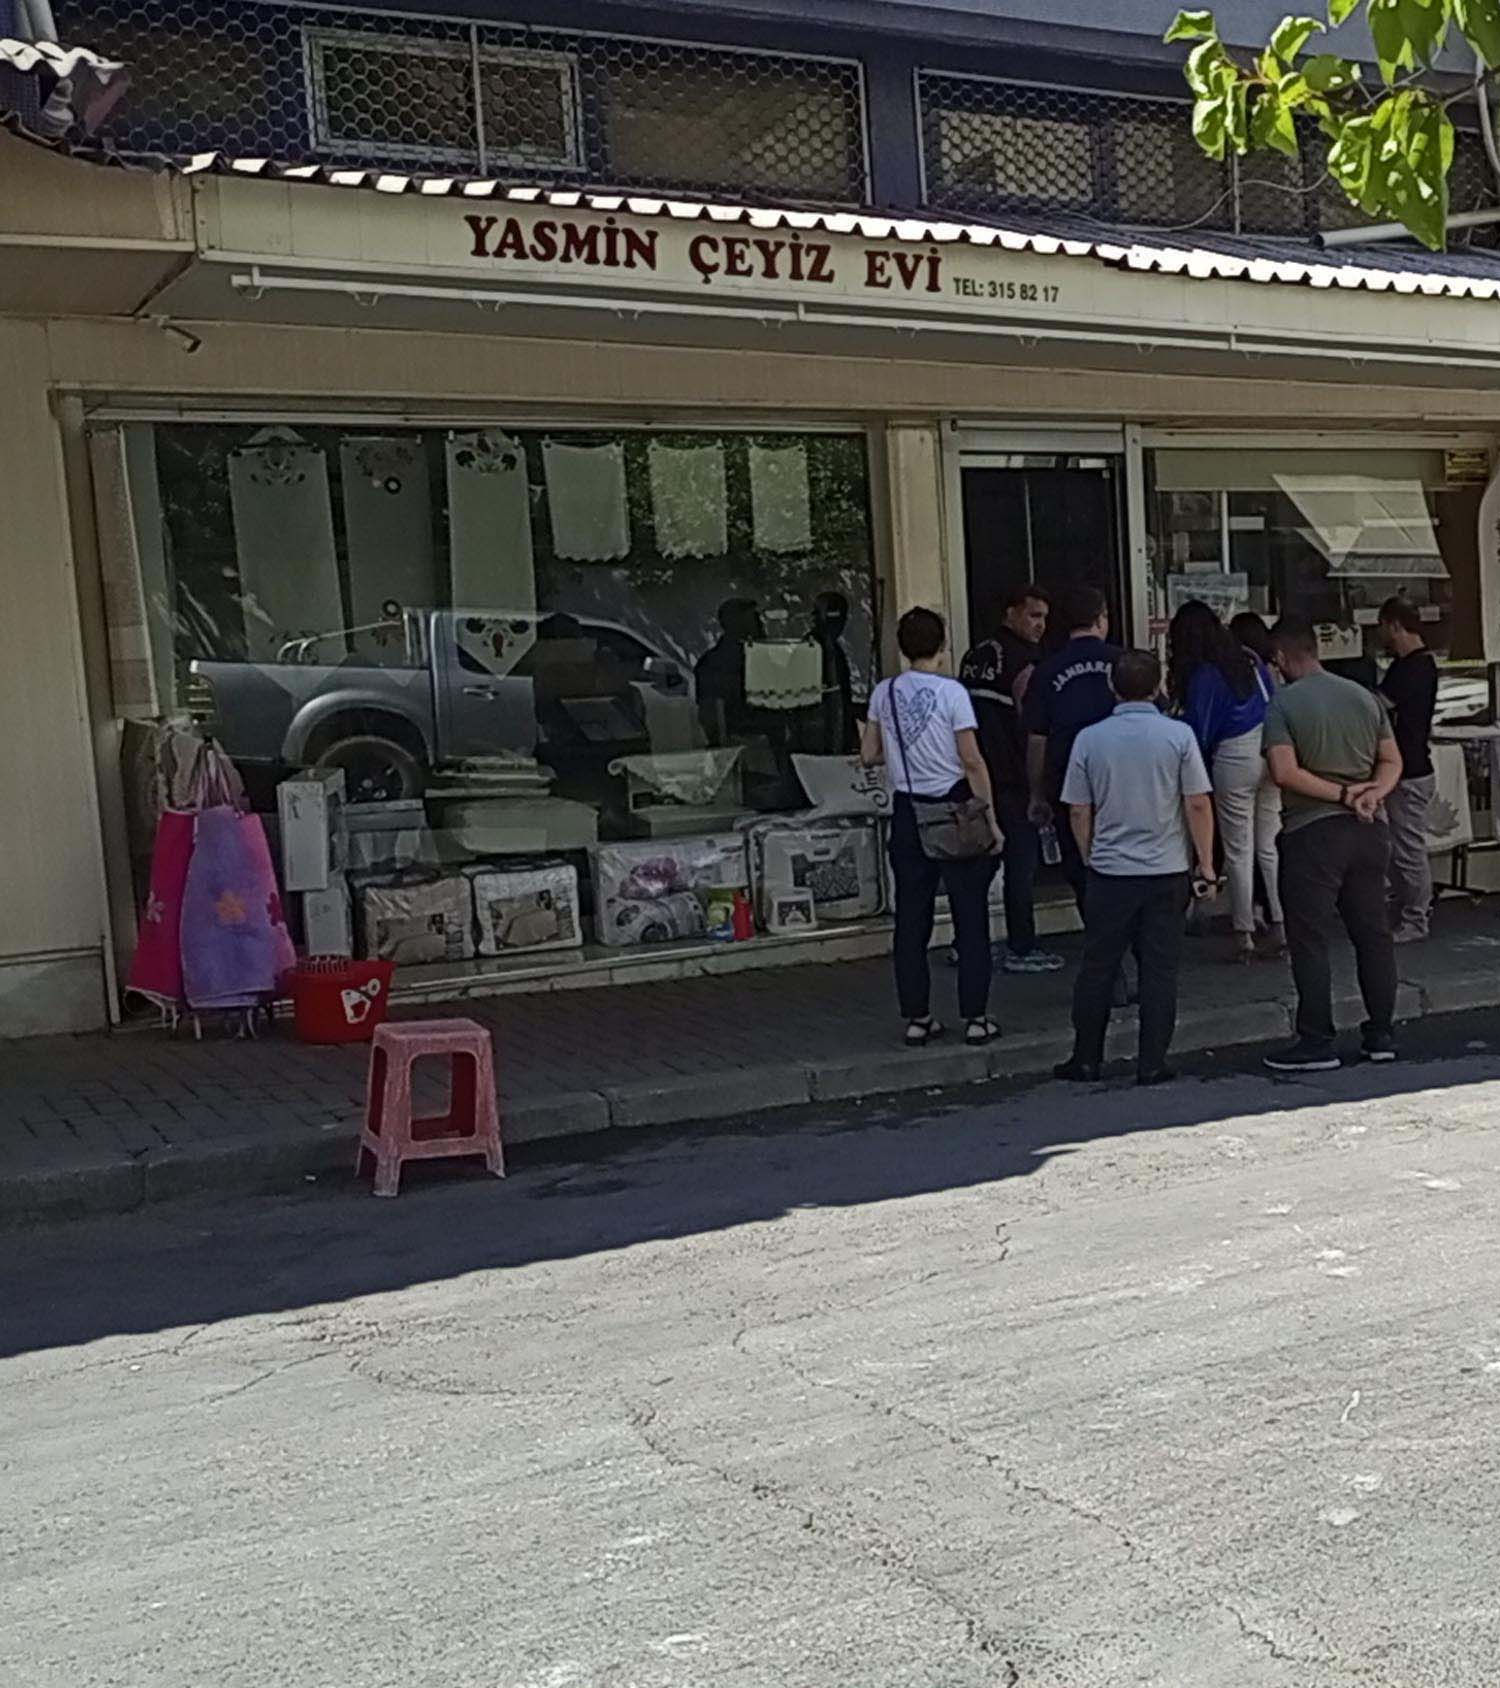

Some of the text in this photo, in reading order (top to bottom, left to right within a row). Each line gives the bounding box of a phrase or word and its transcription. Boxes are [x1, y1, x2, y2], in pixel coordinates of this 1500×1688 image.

[464, 215, 942, 292] YASMİN ÇEYİZ EVİ
[953, 277, 1059, 302] TEL: 315 82 17
[1052, 660, 1113, 692] JANDAR
